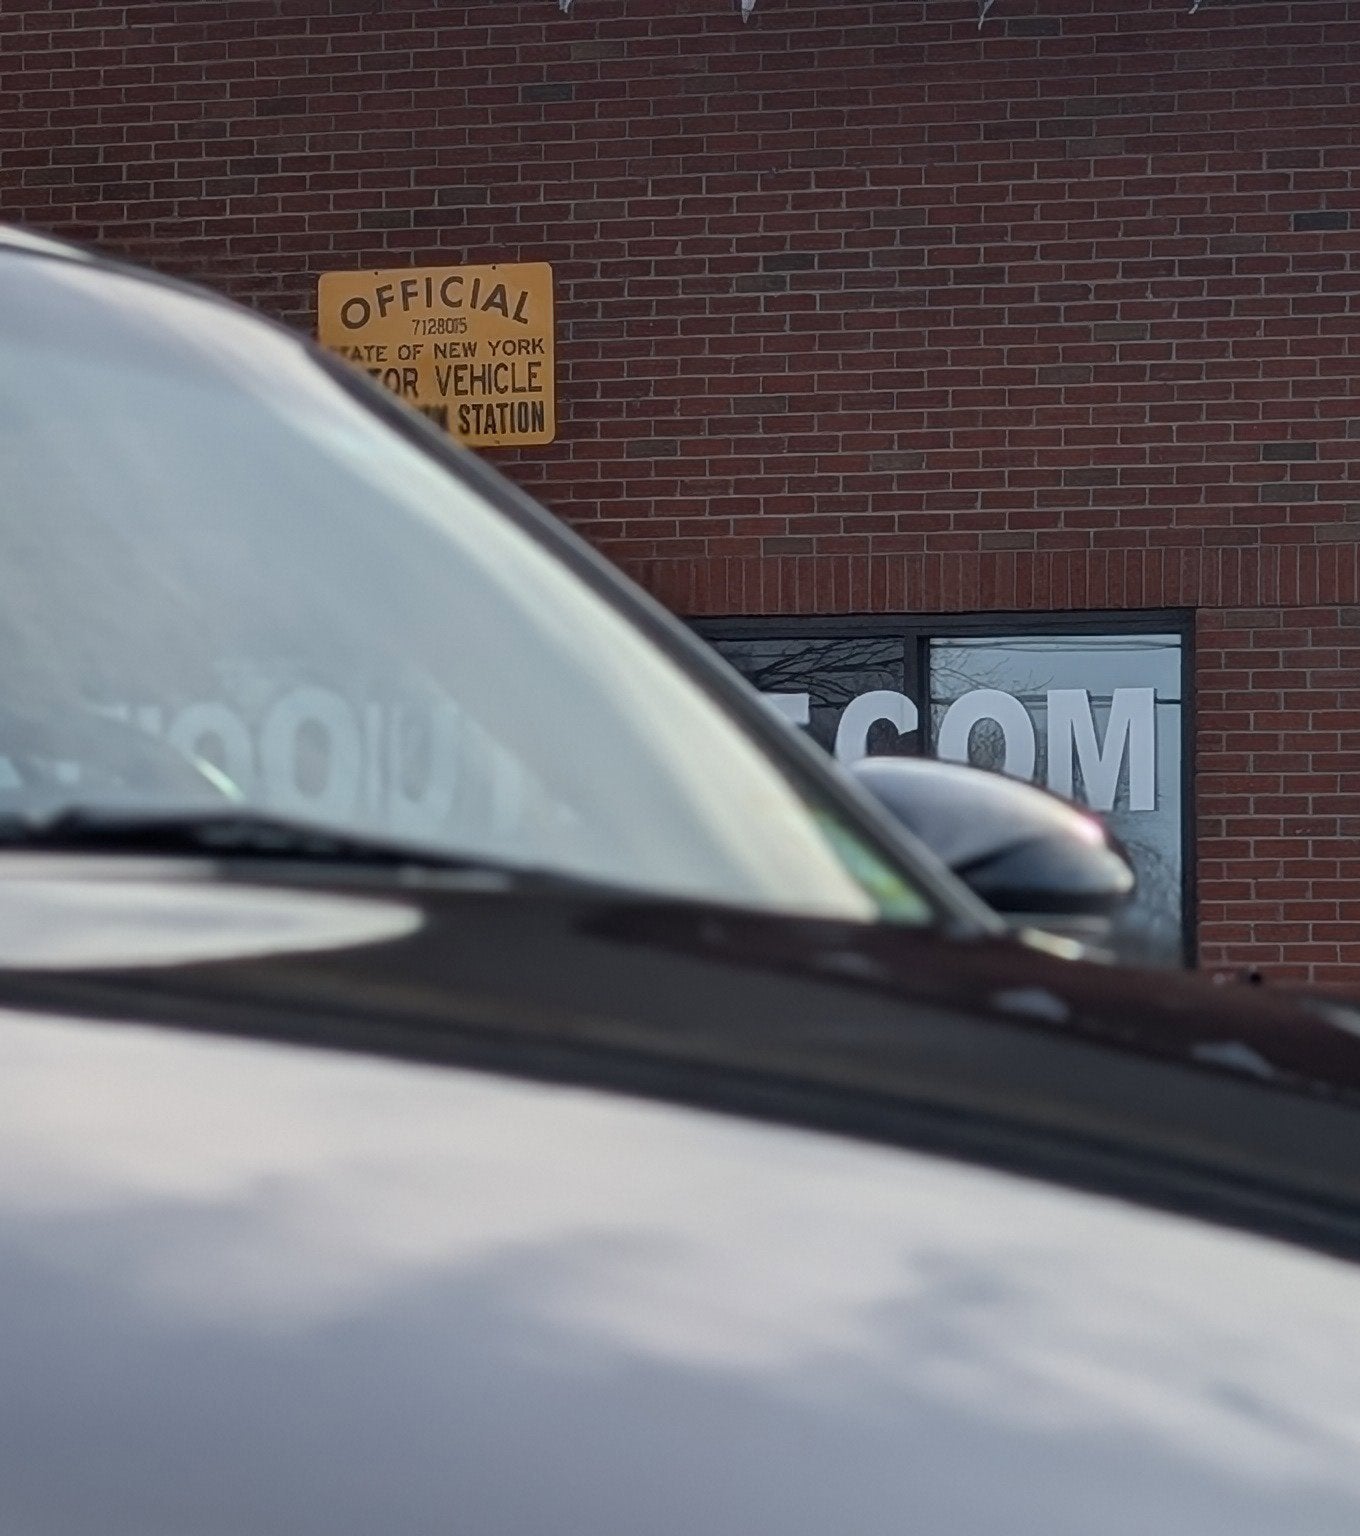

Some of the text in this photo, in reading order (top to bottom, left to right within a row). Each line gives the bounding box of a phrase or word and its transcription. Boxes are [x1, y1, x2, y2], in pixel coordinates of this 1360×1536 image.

[341, 275, 529, 330] OFFICIAL
[398, 343, 424, 361] OF
[433, 341, 478, 360] NEW
[487, 337, 546, 357] YORK
[434, 360, 543, 397] VEHICLE
[457, 400, 546, 436] STATION
